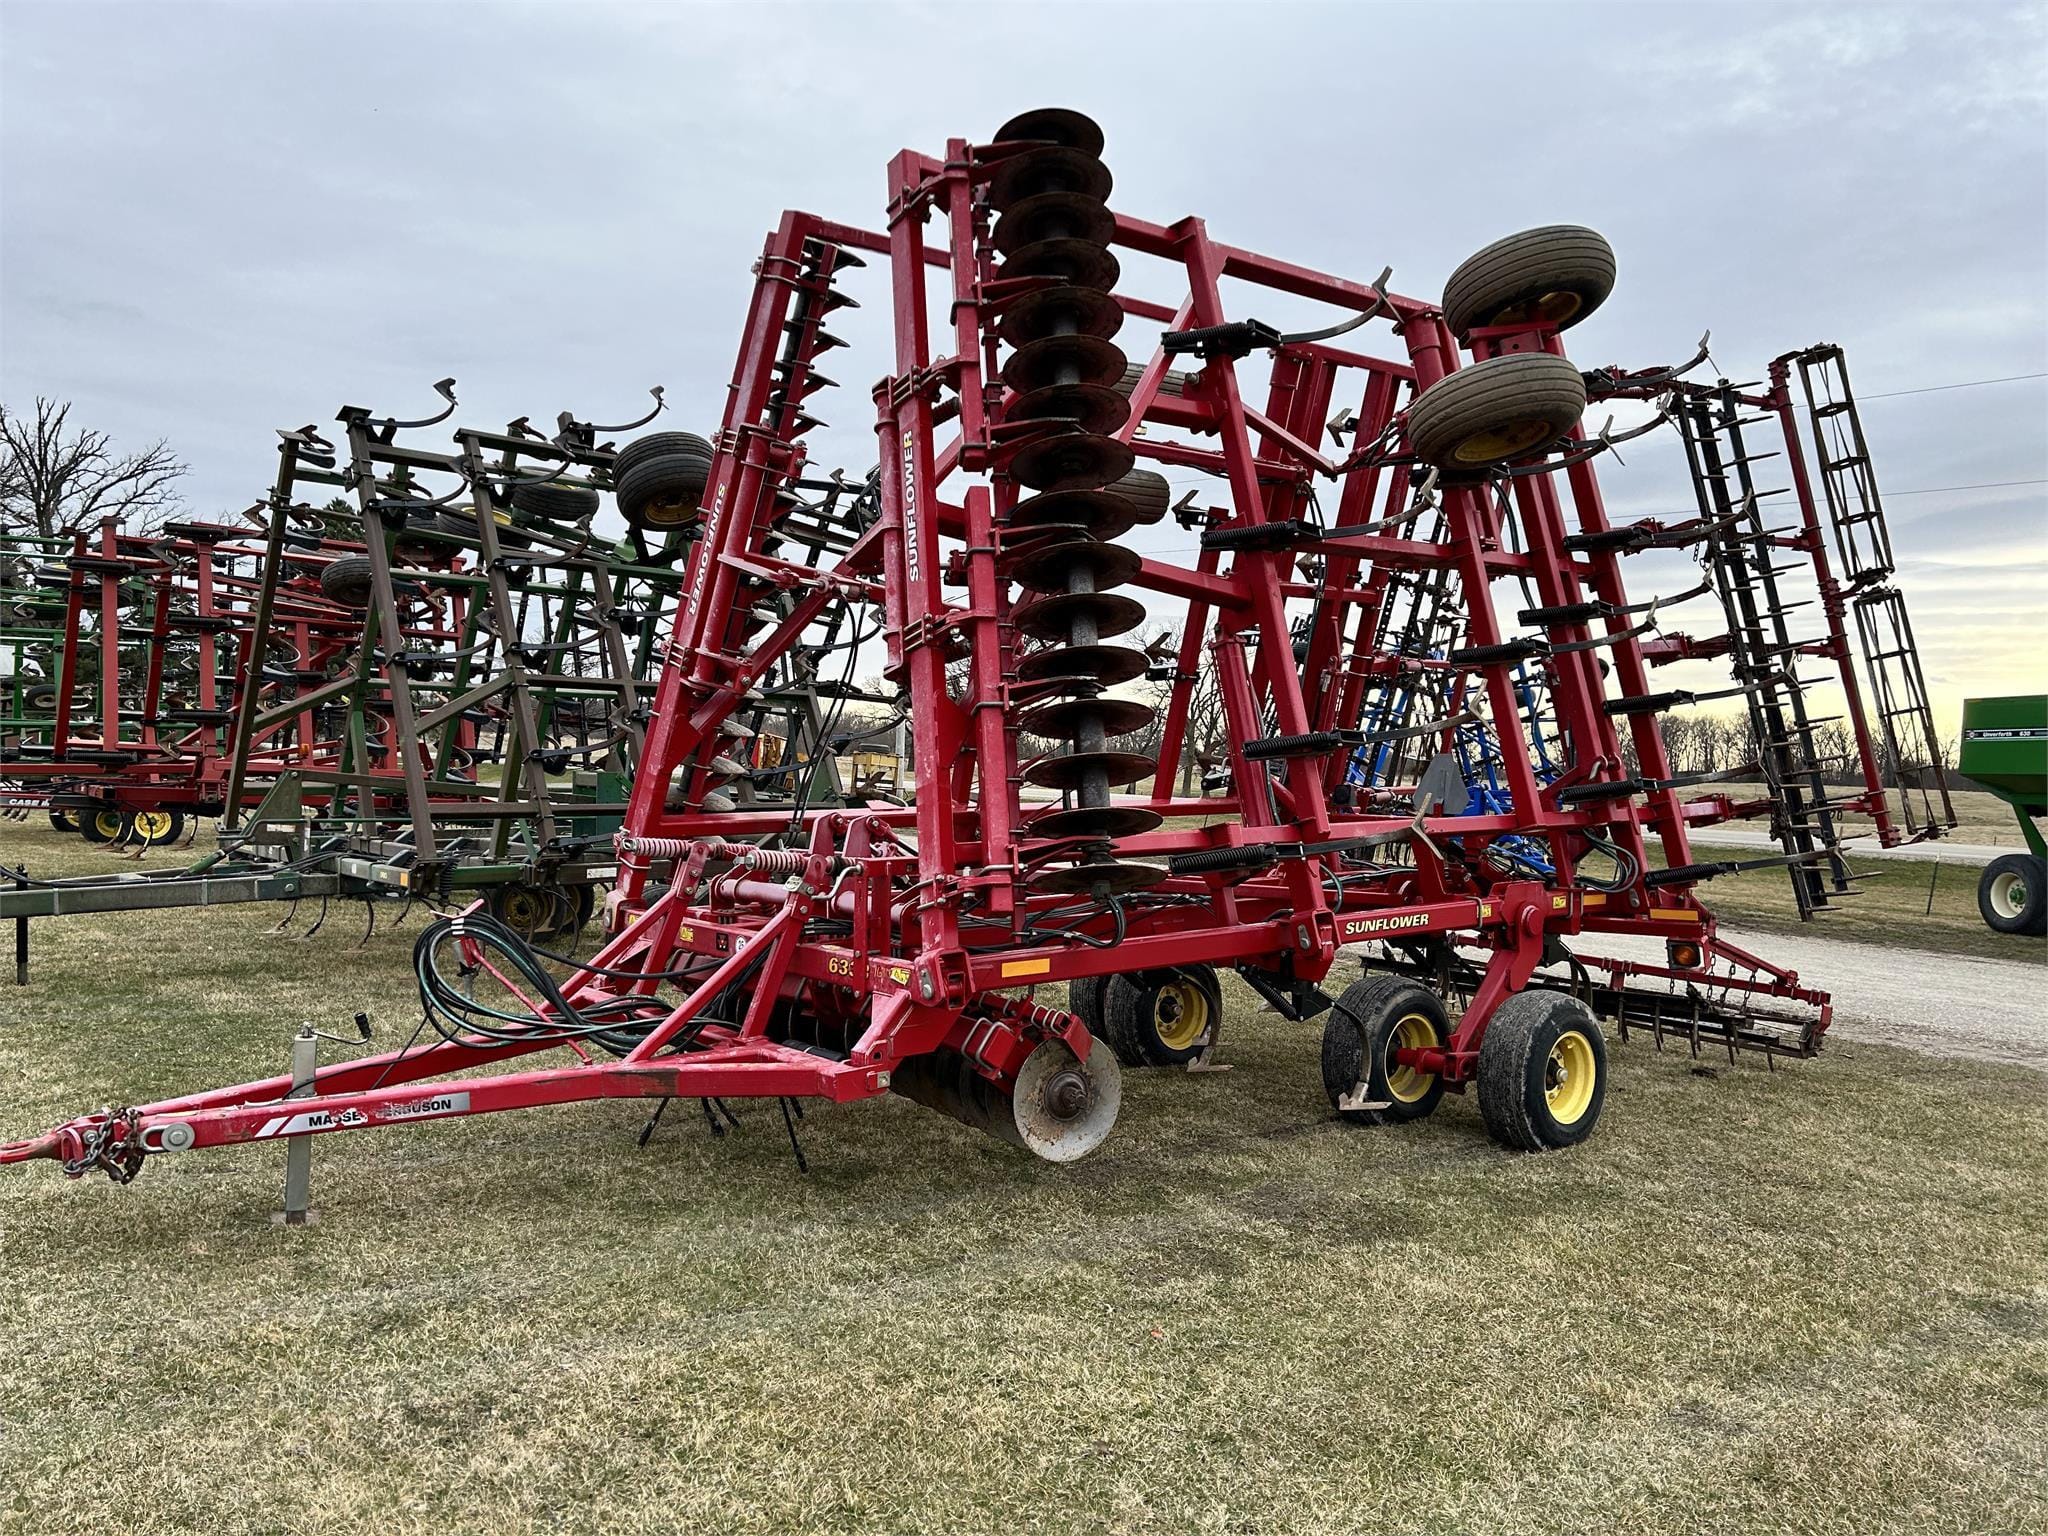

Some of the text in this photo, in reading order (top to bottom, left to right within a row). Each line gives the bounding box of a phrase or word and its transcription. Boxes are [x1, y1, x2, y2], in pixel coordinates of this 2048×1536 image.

[689, 483, 726, 615] SUNFLOWER
[903, 430, 919, 582] SUNFLOWER
[1345, 913, 1429, 935] SUNFLOWER
